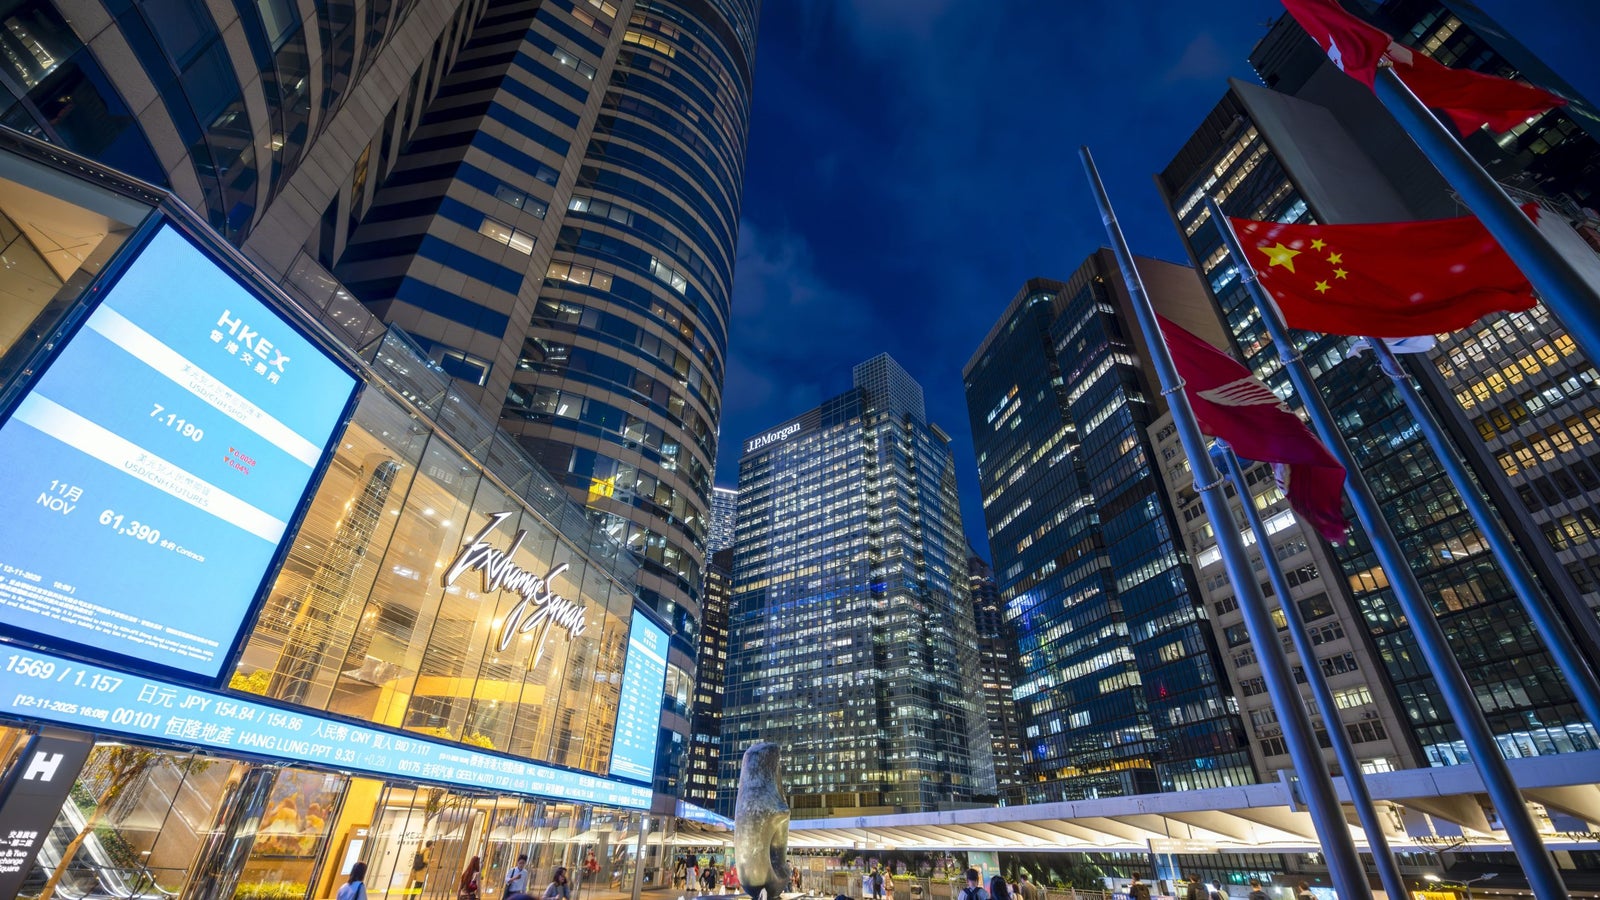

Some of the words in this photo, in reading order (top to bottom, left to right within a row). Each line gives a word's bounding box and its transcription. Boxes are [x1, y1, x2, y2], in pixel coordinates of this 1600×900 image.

[209, 329, 281, 385] 香港交易所
[216, 309, 291, 373] HKEX
[149, 403, 204, 442] 7.1190
[746, 422, 801, 453] J.P.Morgan
[36, 491, 76, 516] NOV
[49, 479, 84, 503] 11月
[98, 508, 161, 545] 61,390
[176, 545, 206, 563] Contracts
[441, 511, 545, 652] Exchange
[519, 562, 588, 672] Square
[0, 654, 55, 680] 1569
[74, 670, 123, 693] 1.157
[136, 683, 177, 709] 日元
[179, 694, 212, 712] JPY
[214, 701, 256, 721] 154.84
[267, 713, 304, 732] 154.86
[310, 721, 349, 742] 人民幣
[350, 730, 372, 745] CNY
[111, 707, 161, 730] 00101
[164, 715, 235, 746] 恒隆地產
[237, 730, 276, 750] HANG
[276, 737, 310, 756] LUNG
[309, 744, 333, 759] PPT
[334, 748, 355, 762] 9.33
[23, 751, 64, 782] H
[13, 849, 28, 857] Two
